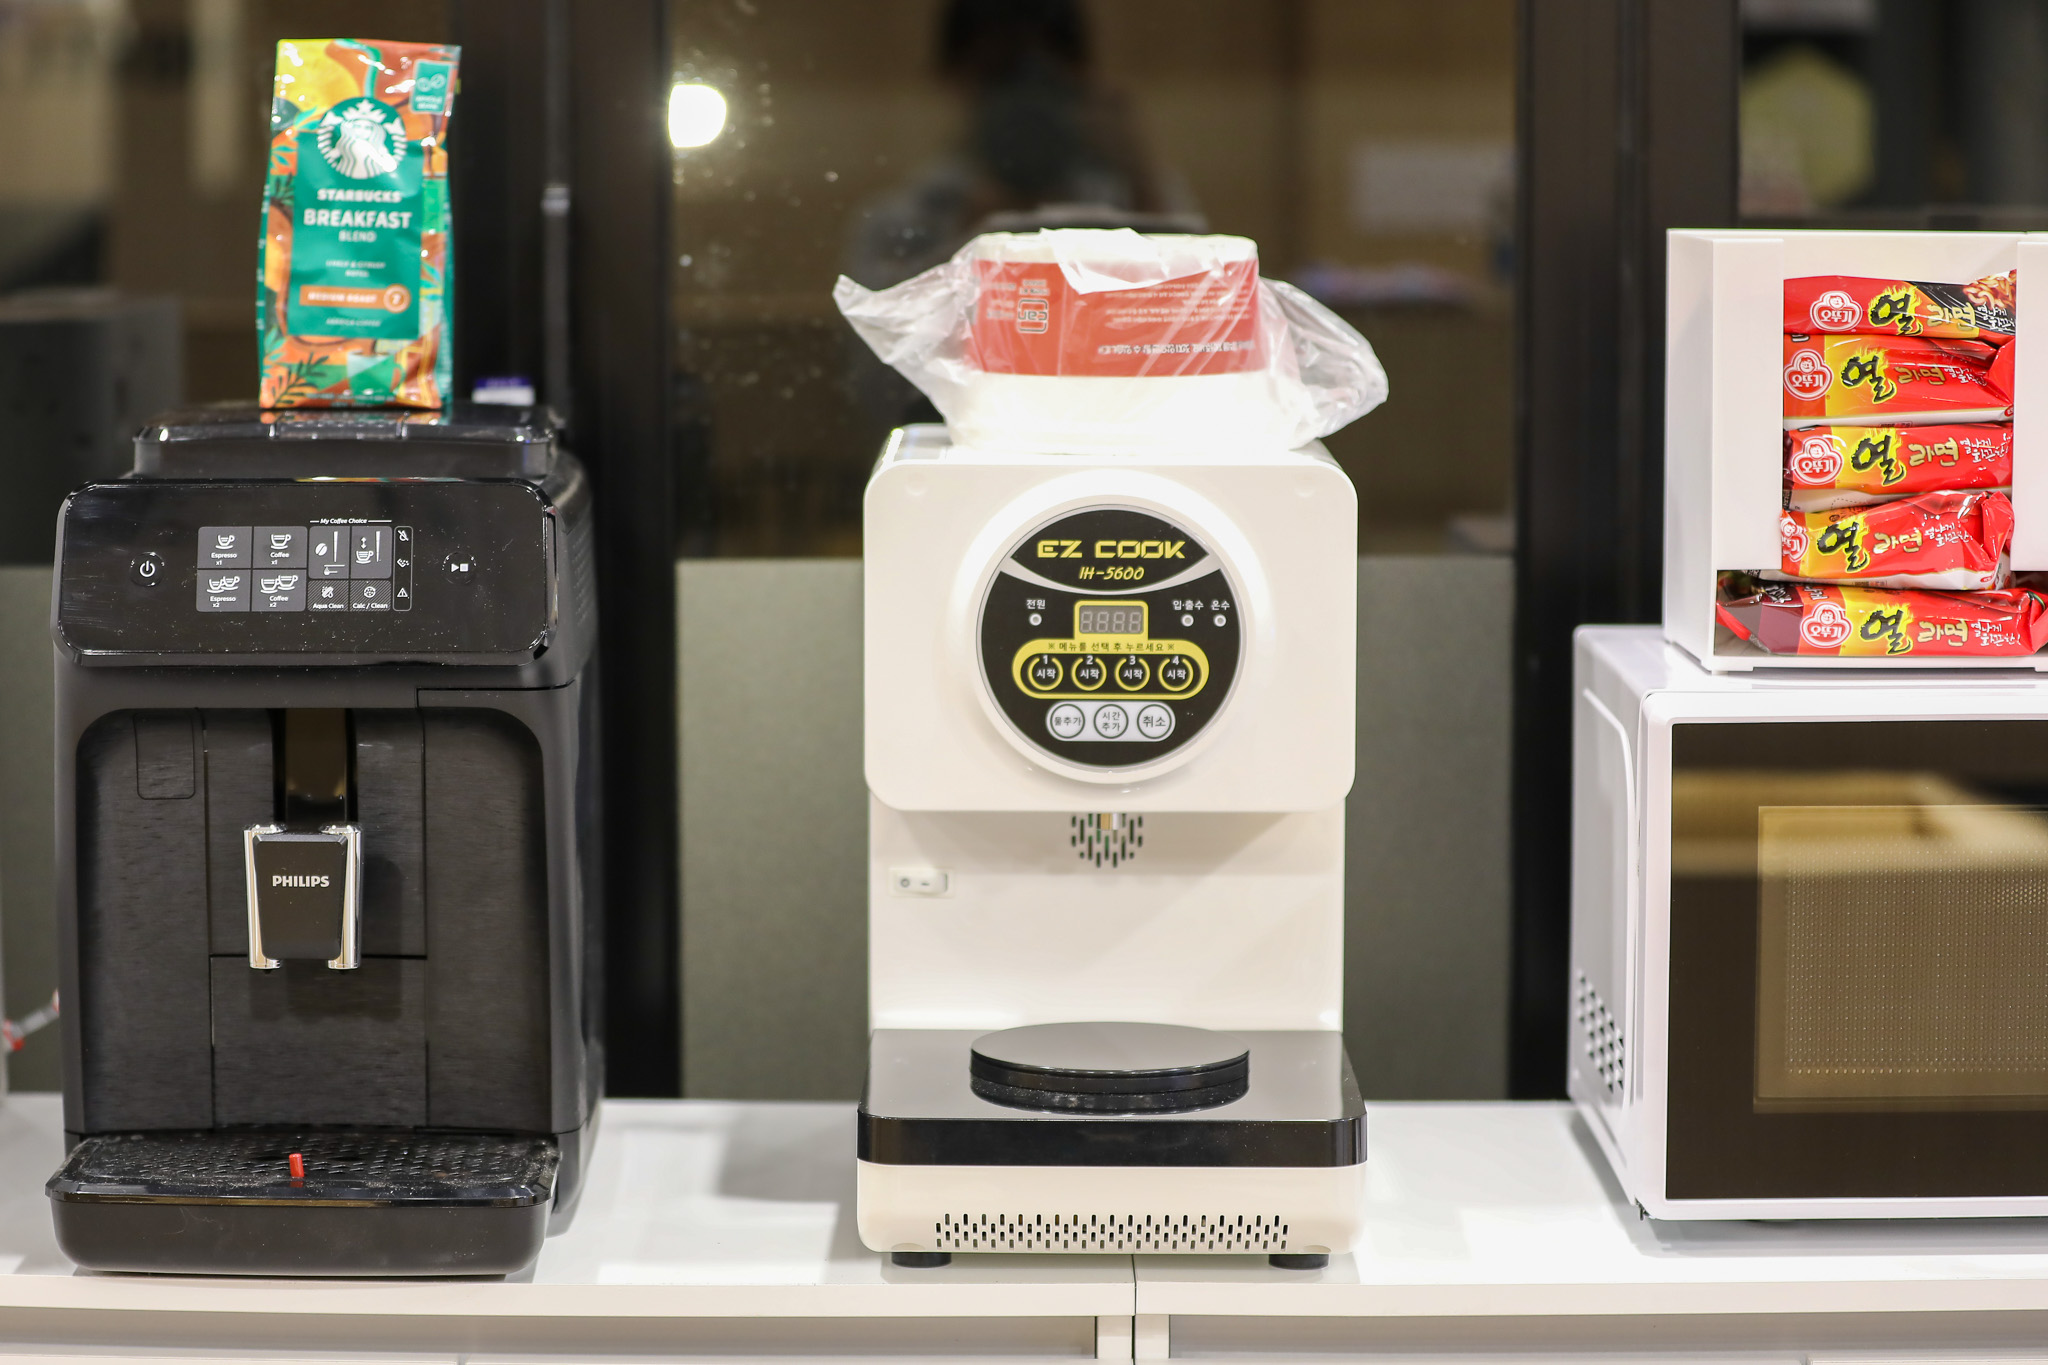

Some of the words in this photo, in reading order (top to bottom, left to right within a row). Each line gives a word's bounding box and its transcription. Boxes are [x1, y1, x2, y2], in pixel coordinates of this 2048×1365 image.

[317, 189, 402, 203] STARBUCKS
[304, 209, 412, 229] BREAKFAST
[338, 231, 377, 243] BLEND
[308, 292, 345, 302] MEDIUM
[348, 294, 378, 303] ROAST
[1821, 310, 1852, 323] 오뚜기
[1871, 293, 1922, 335] 열
[1926, 302, 1976, 330] 라면
[1792, 374, 1824, 387] 오뚜기
[1842, 355, 1896, 403] 열
[1895, 367, 1944, 385] 라면
[1960, 437, 1992, 455] 열나게
[1852, 435, 1904, 485] 열
[1909, 438, 1959, 467] 라면
[1802, 461, 1834, 473] 오뚜기
[1037, 540, 1083, 559] EZ
[1095, 540, 1186, 559] COOK
[1817, 521, 1868, 572] 열
[1873, 528, 1922, 553] 라면
[1079, 566, 1145, 581] IH-5600
[1026, 599, 1046, 610] 전원
[1211, 599, 1230, 610] 온수
[1810, 625, 1842, 637] 오뚜기
[1861, 610, 1911, 653] 열
[1918, 620, 1968, 646] 라면
[1971, 621, 2002, 637] 열나게
[1059, 641, 1087, 652] 메뉴를
[1091, 641, 1110, 652] 선택
[1113, 641, 1122, 652] 후
[1125, 642, 1164, 652] 누르세요
[1043, 655, 1048, 665] 1
[1086, 655, 1093, 665] 2
[1129, 655, 1136, 665] 3
[1172, 655, 1180, 665] 4
[1037, 668, 1056, 680] 시작
[1080, 668, 1100, 680] 시작
[1124, 668, 1143, 680] 시작
[1167, 668, 1186, 680] 시작
[1054, 716, 1082, 727] 물추가
[1102, 711, 1121, 720] 시간
[1142, 715, 1166, 728] 취소
[1102, 721, 1121, 732] 추가
[272, 875, 330, 888] PHILIPS
